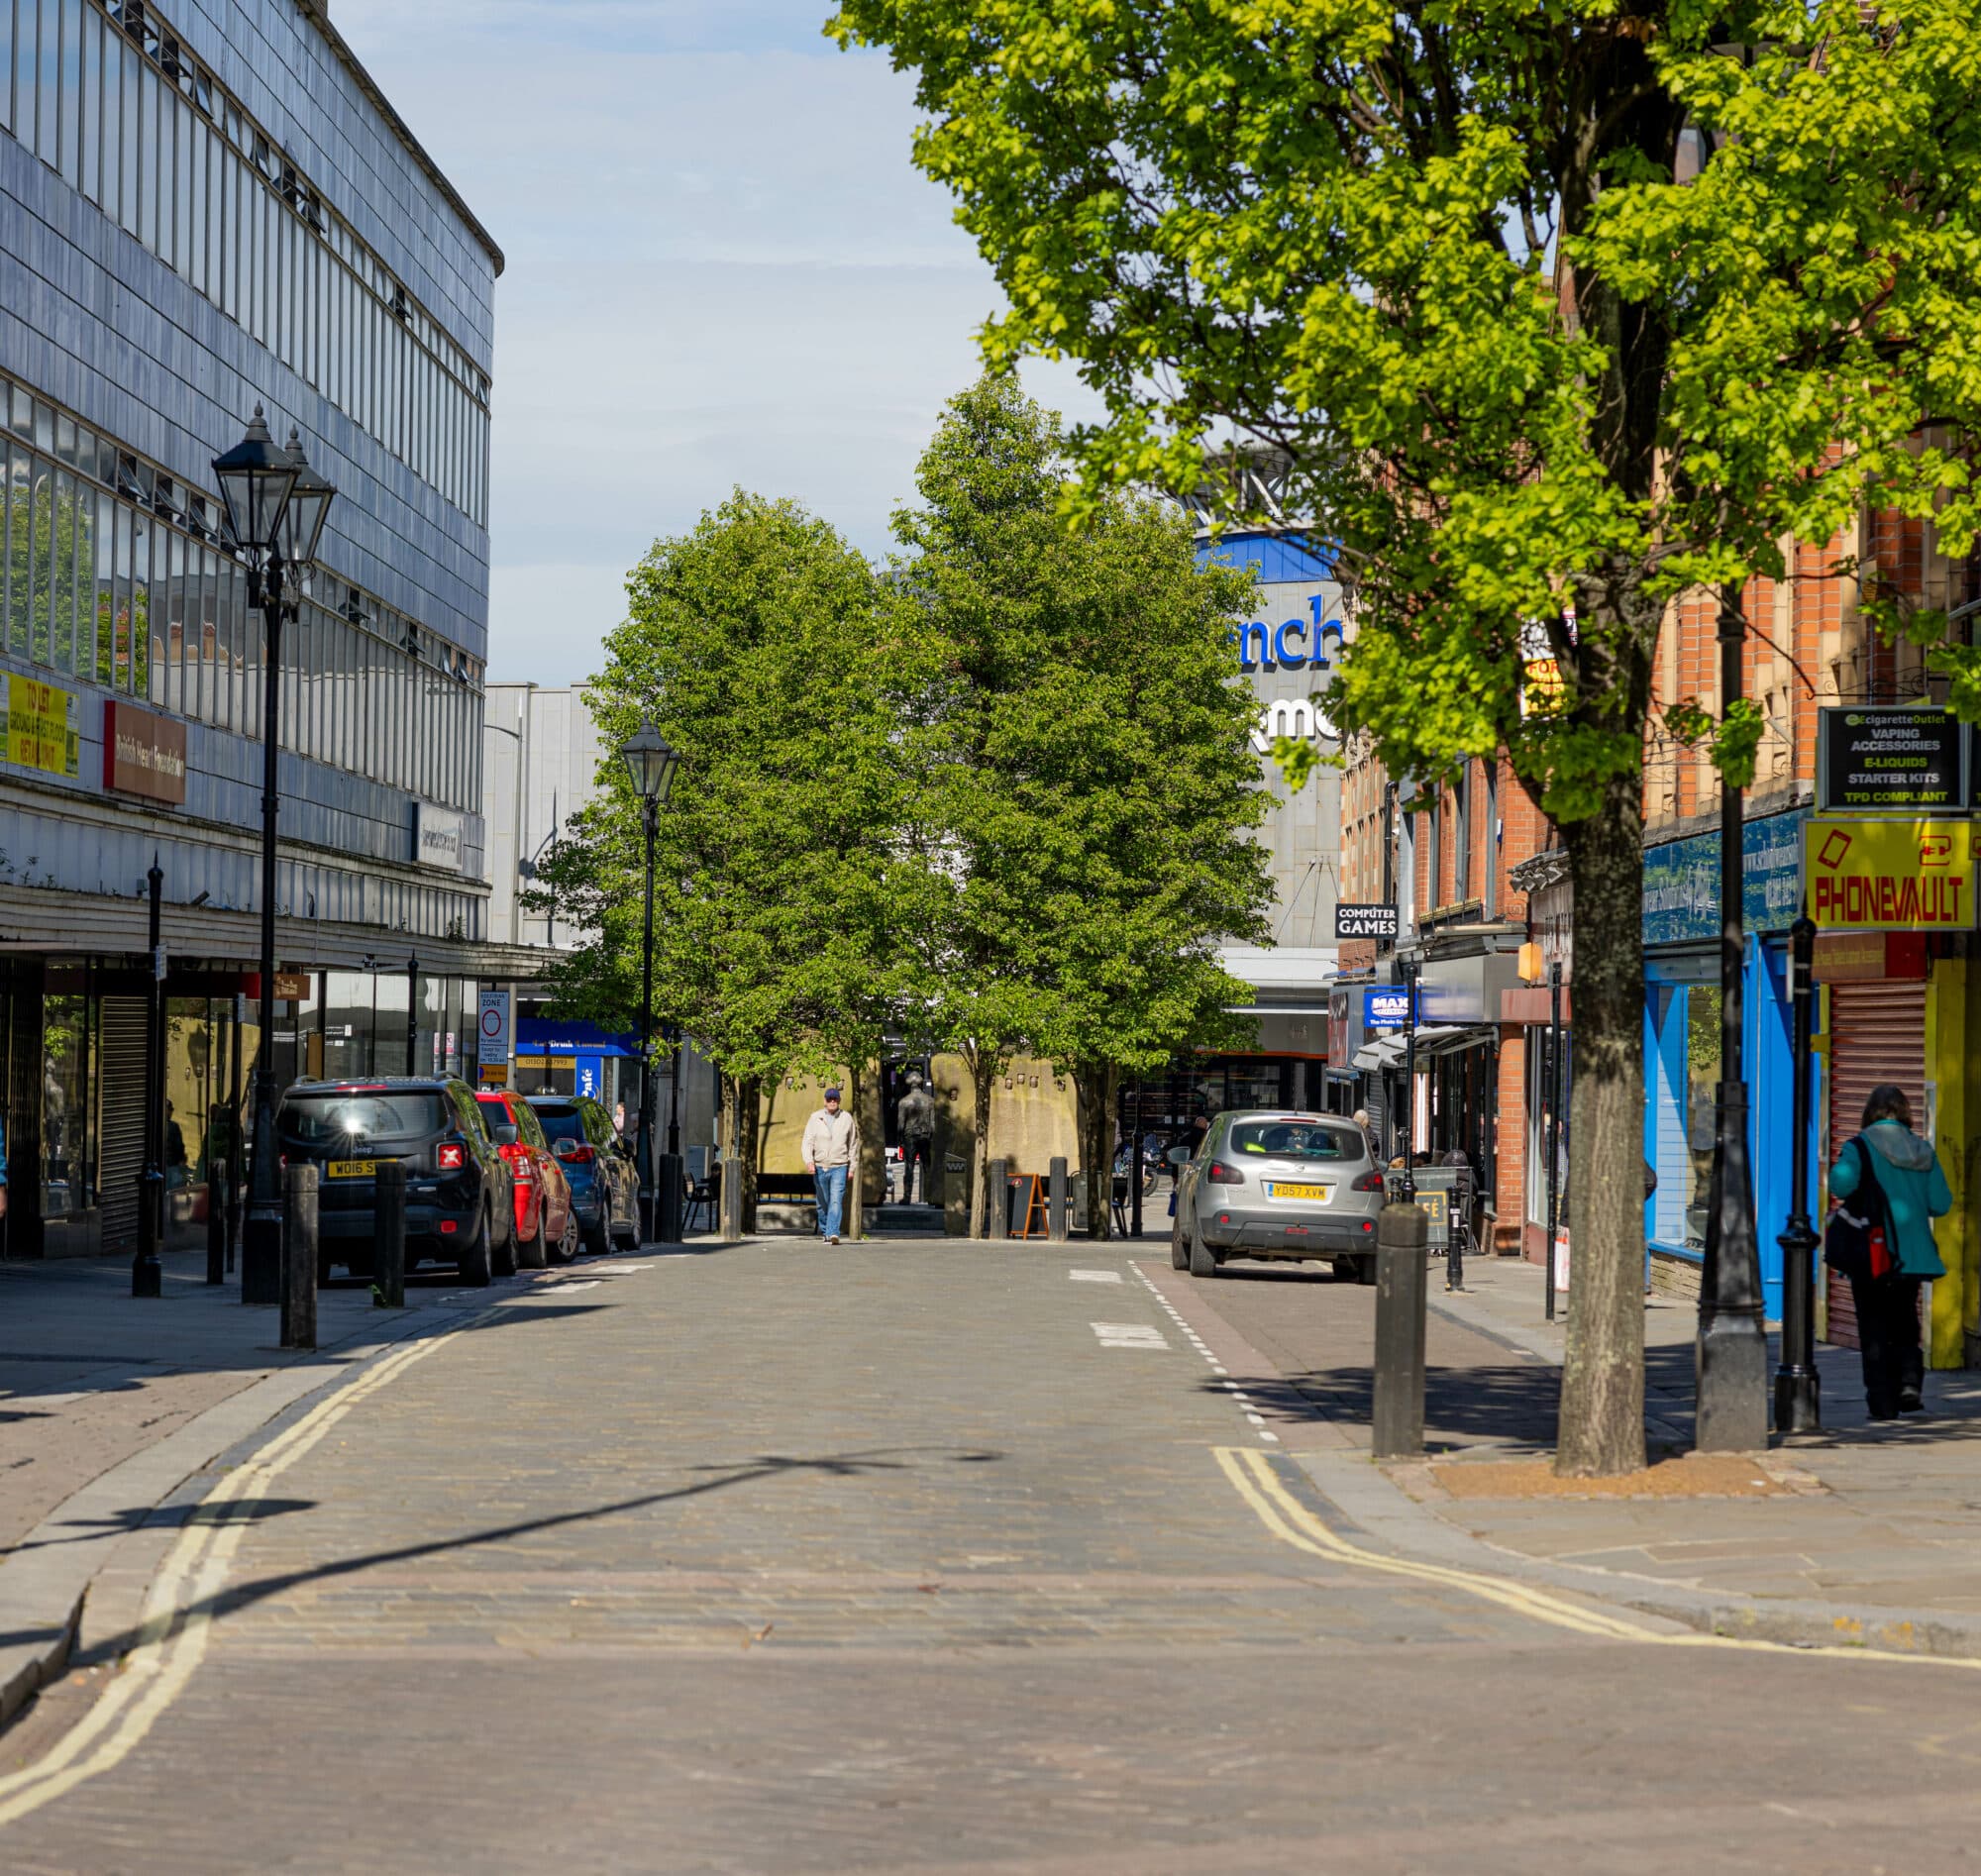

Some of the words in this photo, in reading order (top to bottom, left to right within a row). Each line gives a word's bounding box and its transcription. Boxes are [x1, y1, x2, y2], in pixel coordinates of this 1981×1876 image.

[27, 681, 37, 710] TO
[38, 685, 51, 713] LET
[1871, 728, 1920, 739] VAPING
[116, 733, 136, 765] British
[136, 740, 154, 770] Heart
[1850, 741, 1941, 752] ACCESSORIES
[1864, 758, 1929, 768] E-LIQUIDS
[1848, 774, 1907, 783] STARTER
[1910, 774, 1940, 783] KITS
[1845, 792, 1870, 802] TPD
[1873, 791, 1948, 802] COMPLIANT
[1816, 877, 1963, 922] PHONEVAULT
[1339, 908, 1396, 918] COMPUTER
[1339, 920, 1397, 934] GAMES
[1372, 997, 1408, 1008] MAX
